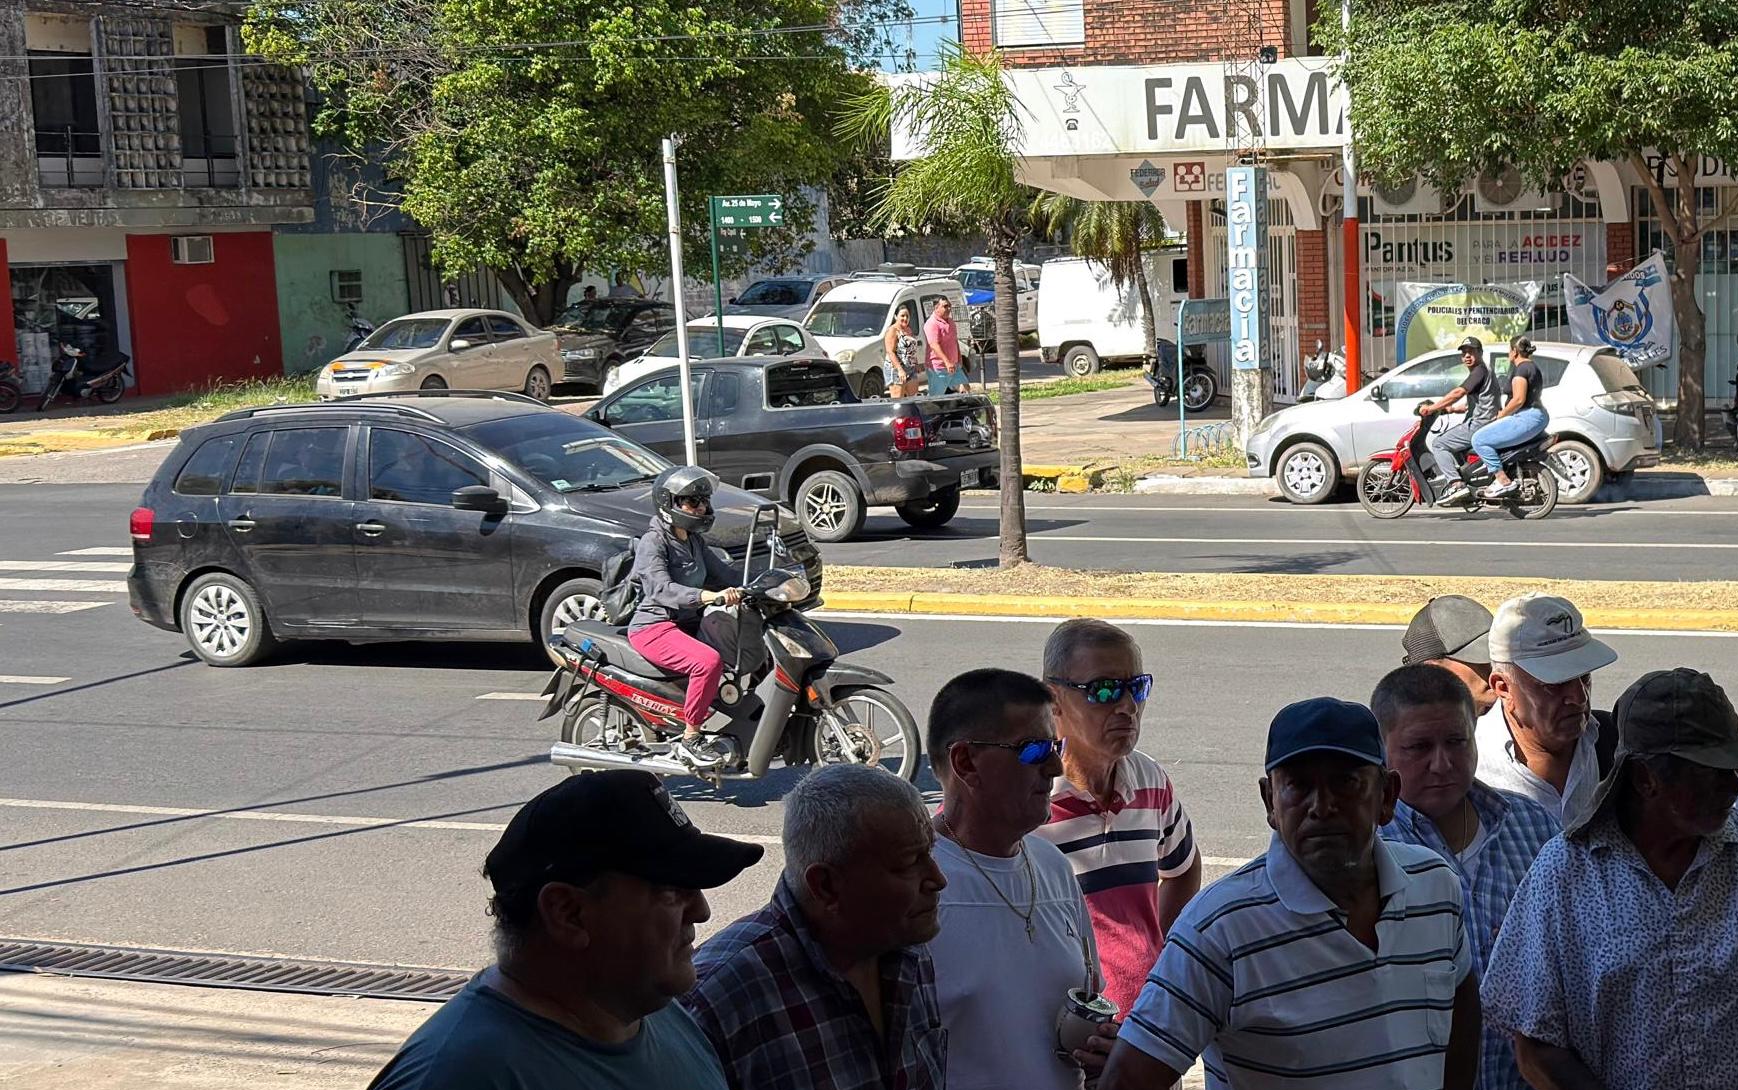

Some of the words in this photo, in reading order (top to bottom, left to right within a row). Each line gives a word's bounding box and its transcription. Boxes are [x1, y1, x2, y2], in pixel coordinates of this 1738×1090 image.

[1144, 71, 1343, 140] FARM
[730, 199, 738, 207] 25
[746, 199, 762, 208] Mayo
[1472, 240, 1502, 249] PARA
[1522, 234, 1582, 247] ACIDEZ
[1364, 231, 1454, 268] Pantus
[1498, 250, 1570, 264] REFLUJO
[1231, 172, 1256, 362] Farmacia
[1427, 306, 1462, 315] POLICIALES
[1468, 306, 1520, 315] PENITENCIARIOS
[1457, 317, 1468, 326] DEL
[1468, 316, 1491, 326] CHACO
[631, 693, 677, 717] ENERGY
